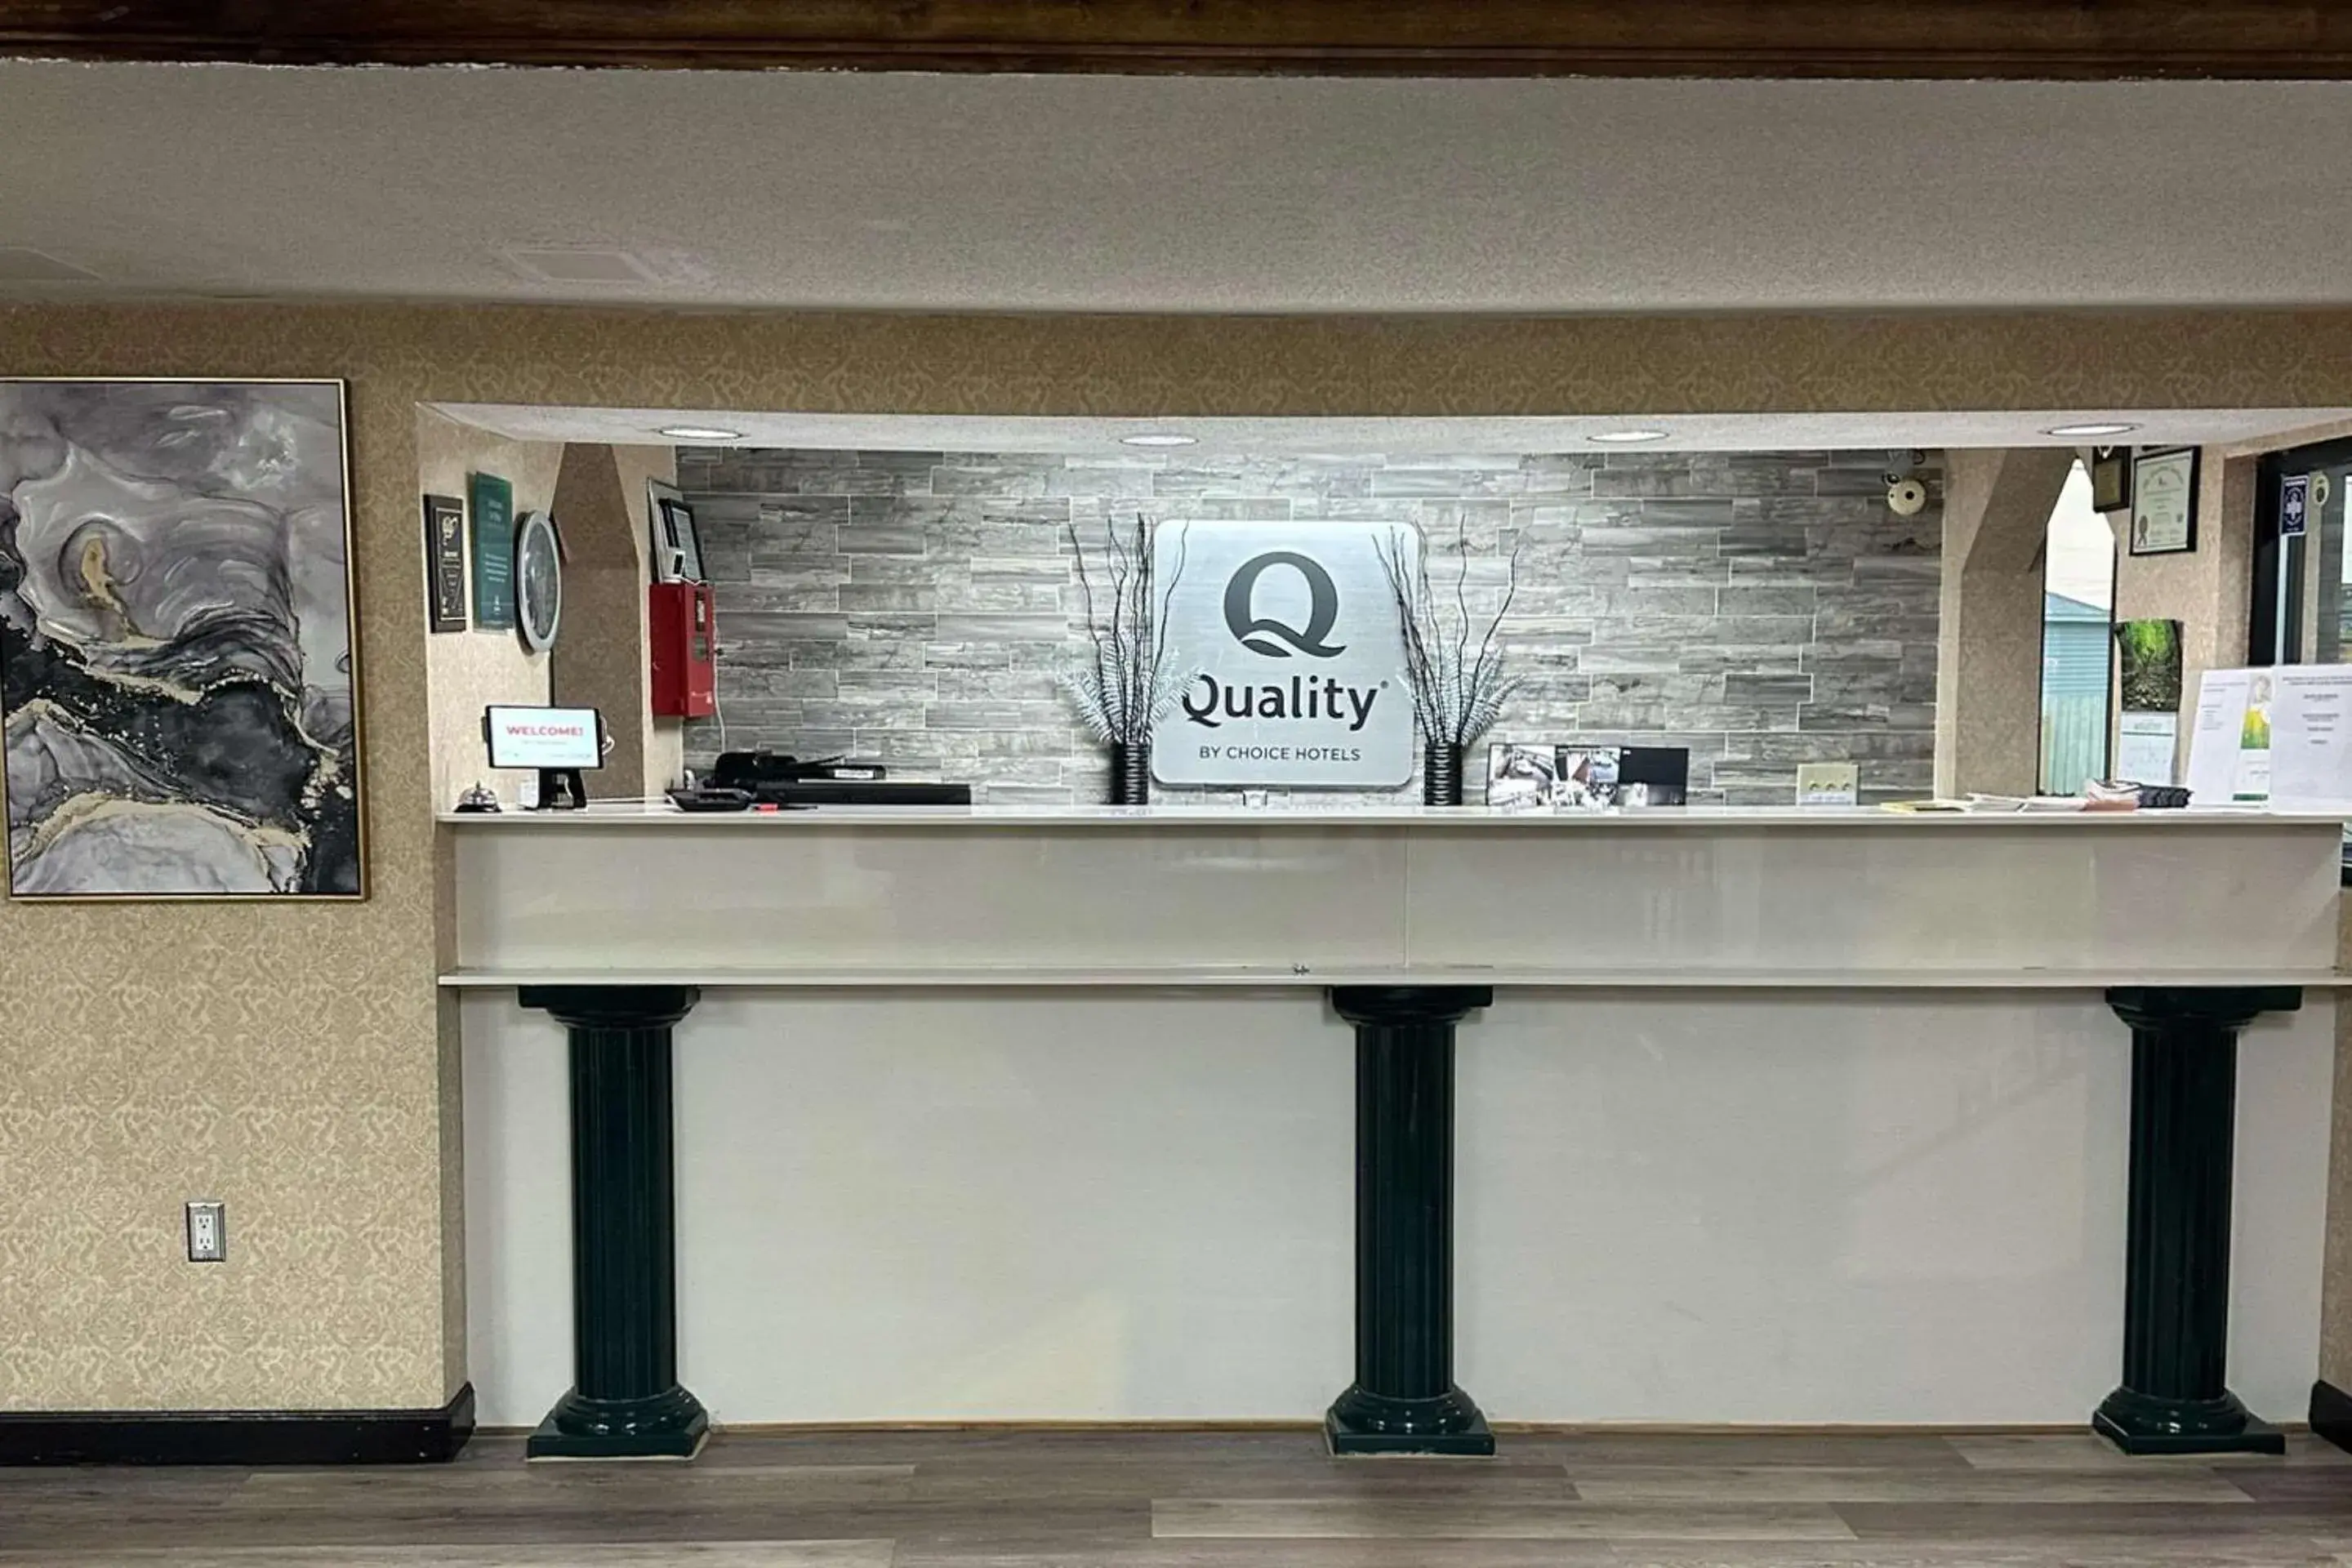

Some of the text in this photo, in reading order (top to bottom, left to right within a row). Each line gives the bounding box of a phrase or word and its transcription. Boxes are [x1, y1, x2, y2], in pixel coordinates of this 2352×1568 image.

[1223, 550, 1347, 658] Q
[1182, 673, 1379, 732] Quality
[506, 725, 584, 737] WELCOME!
[1200, 746, 1361, 762] BY CHOICE HOTELS
